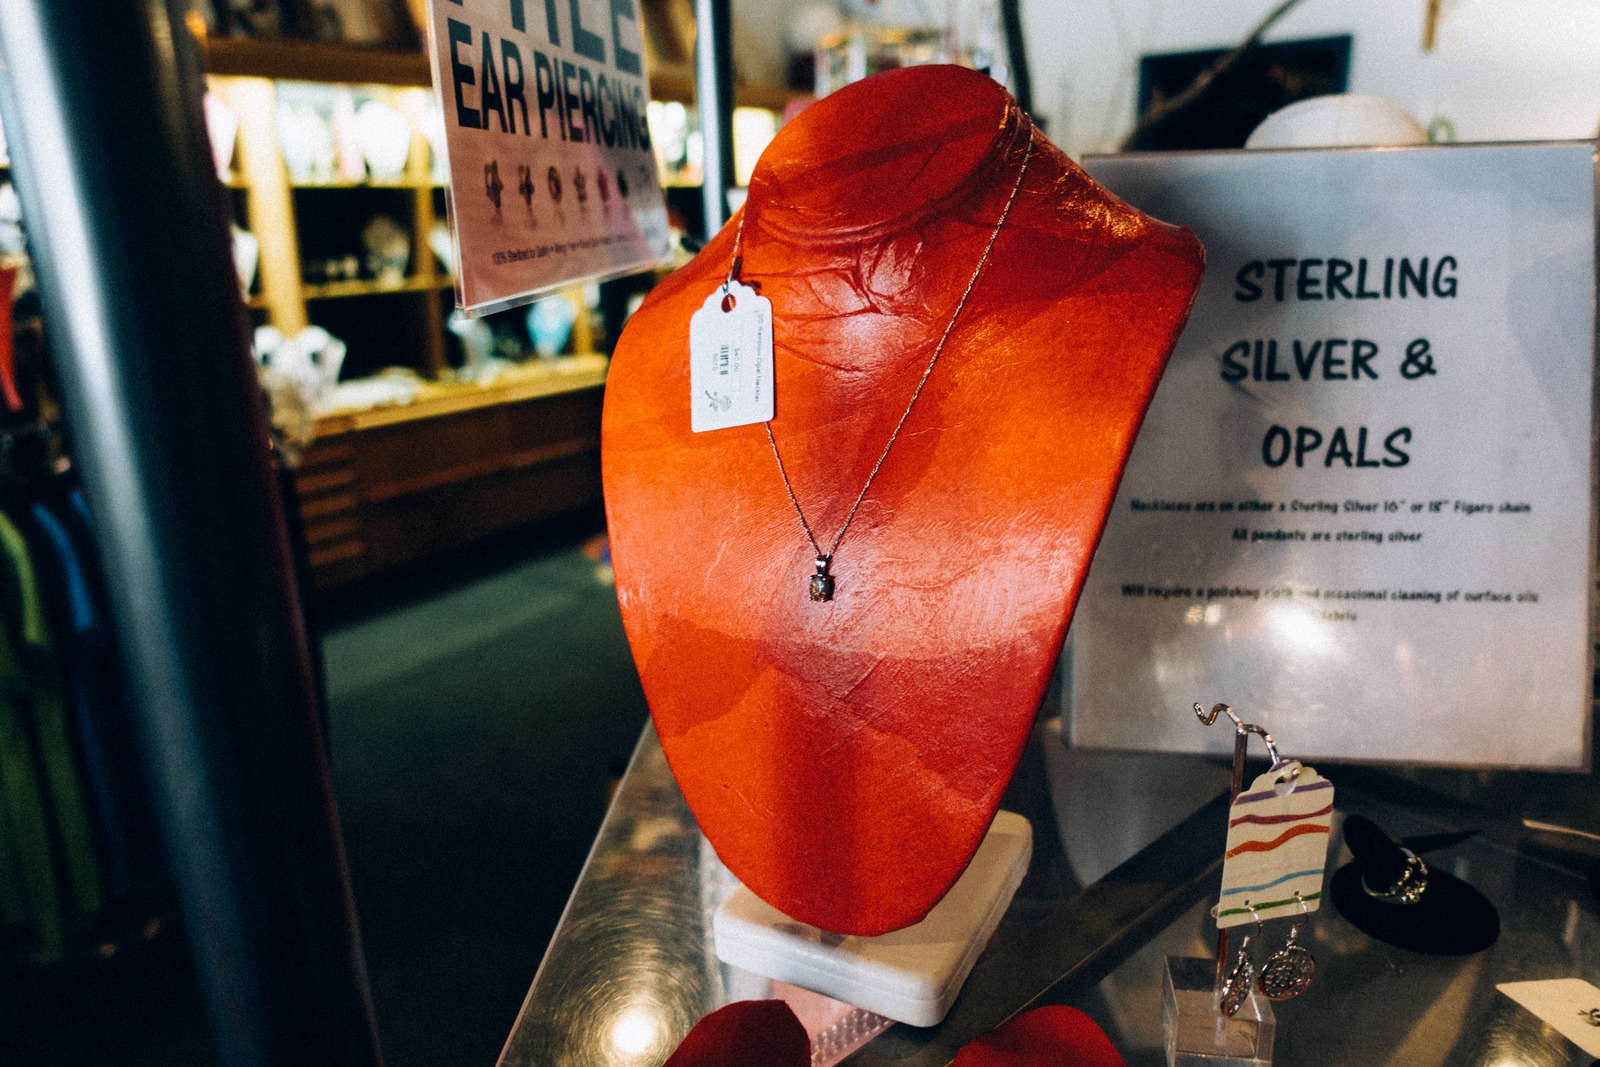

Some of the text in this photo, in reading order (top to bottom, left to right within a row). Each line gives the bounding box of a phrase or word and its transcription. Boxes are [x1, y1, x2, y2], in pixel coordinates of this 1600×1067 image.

[447, 17, 531, 136] EAR
[534, 50, 650, 152] PIERCING
[1234, 256, 1459, 302] STERLING
[755, 358, 764, 373] Opal
[1220, 338, 1437, 382] SILVER &
[1261, 425, 1412, 468] OPALS
[1130, 499, 1191, 512] Necklaces
[1195, 501, 1215, 512] are
[1219, 501, 1233, 512] on
[1238, 499, 1273, 512] either
[1278, 502, 1286, 512] a
[1290, 499, 1338, 514] Sterling
[1343, 499, 1379, 513] Silver
[1410, 503, 1424, 513] or
[1498, 501, 1532, 513] chain
[1231, 527, 1423, 544] All pendants are sterling silver
[1121, 584, 1145, 597] Will
[1148, 585, 1192, 599] require
[1196, 587, 1203, 597] a
[1207, 585, 1260, 600] polishing
[1324, 588, 1387, 600] occasional
[1391, 589, 1441, 603] cleaning
[1446, 588, 1460, 601] of
[1464, 589, 1511, 602] surface
